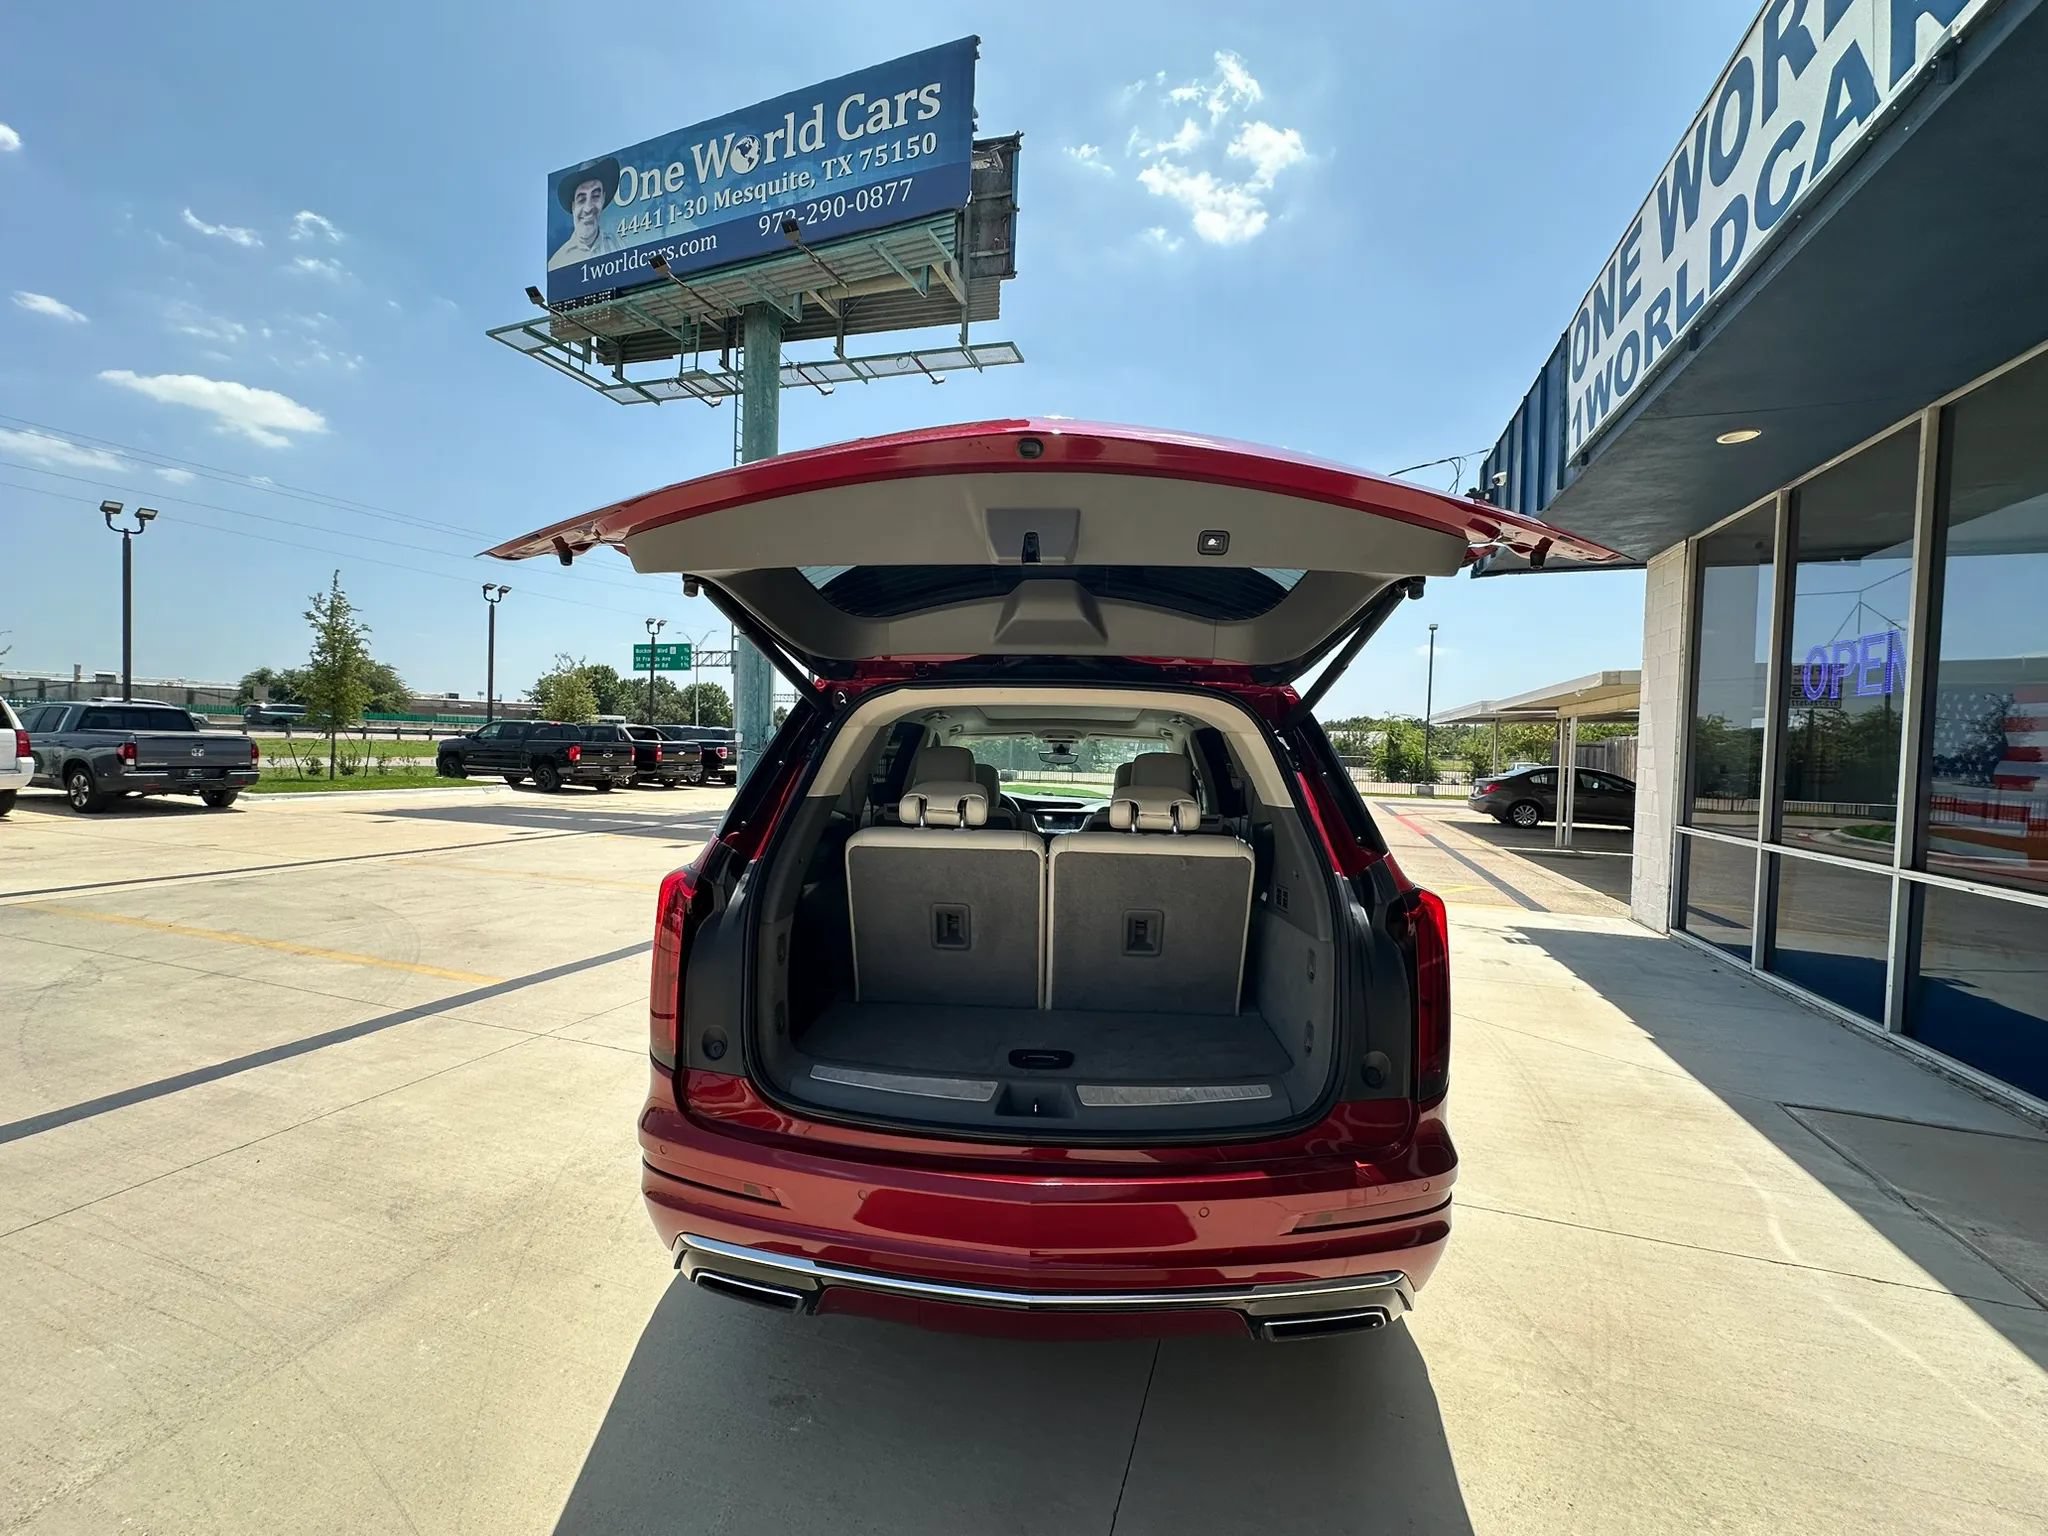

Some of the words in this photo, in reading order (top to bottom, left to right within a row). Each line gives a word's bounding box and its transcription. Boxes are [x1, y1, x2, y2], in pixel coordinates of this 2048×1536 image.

[613, 165, 685, 207] One
[836, 83, 941, 141] Cars
[617, 208, 663, 237] 4441
[669, 197, 708, 225] I-30
[713, 171, 816, 212] Mesquite,
[821, 153, 854, 181] TX
[859, 132, 937, 171] 75150
[1571, 215, 1643, 385] ONE
[1656, 0, 1857, 263] WOR
[1803, 629, 1907, 701] OPEN
